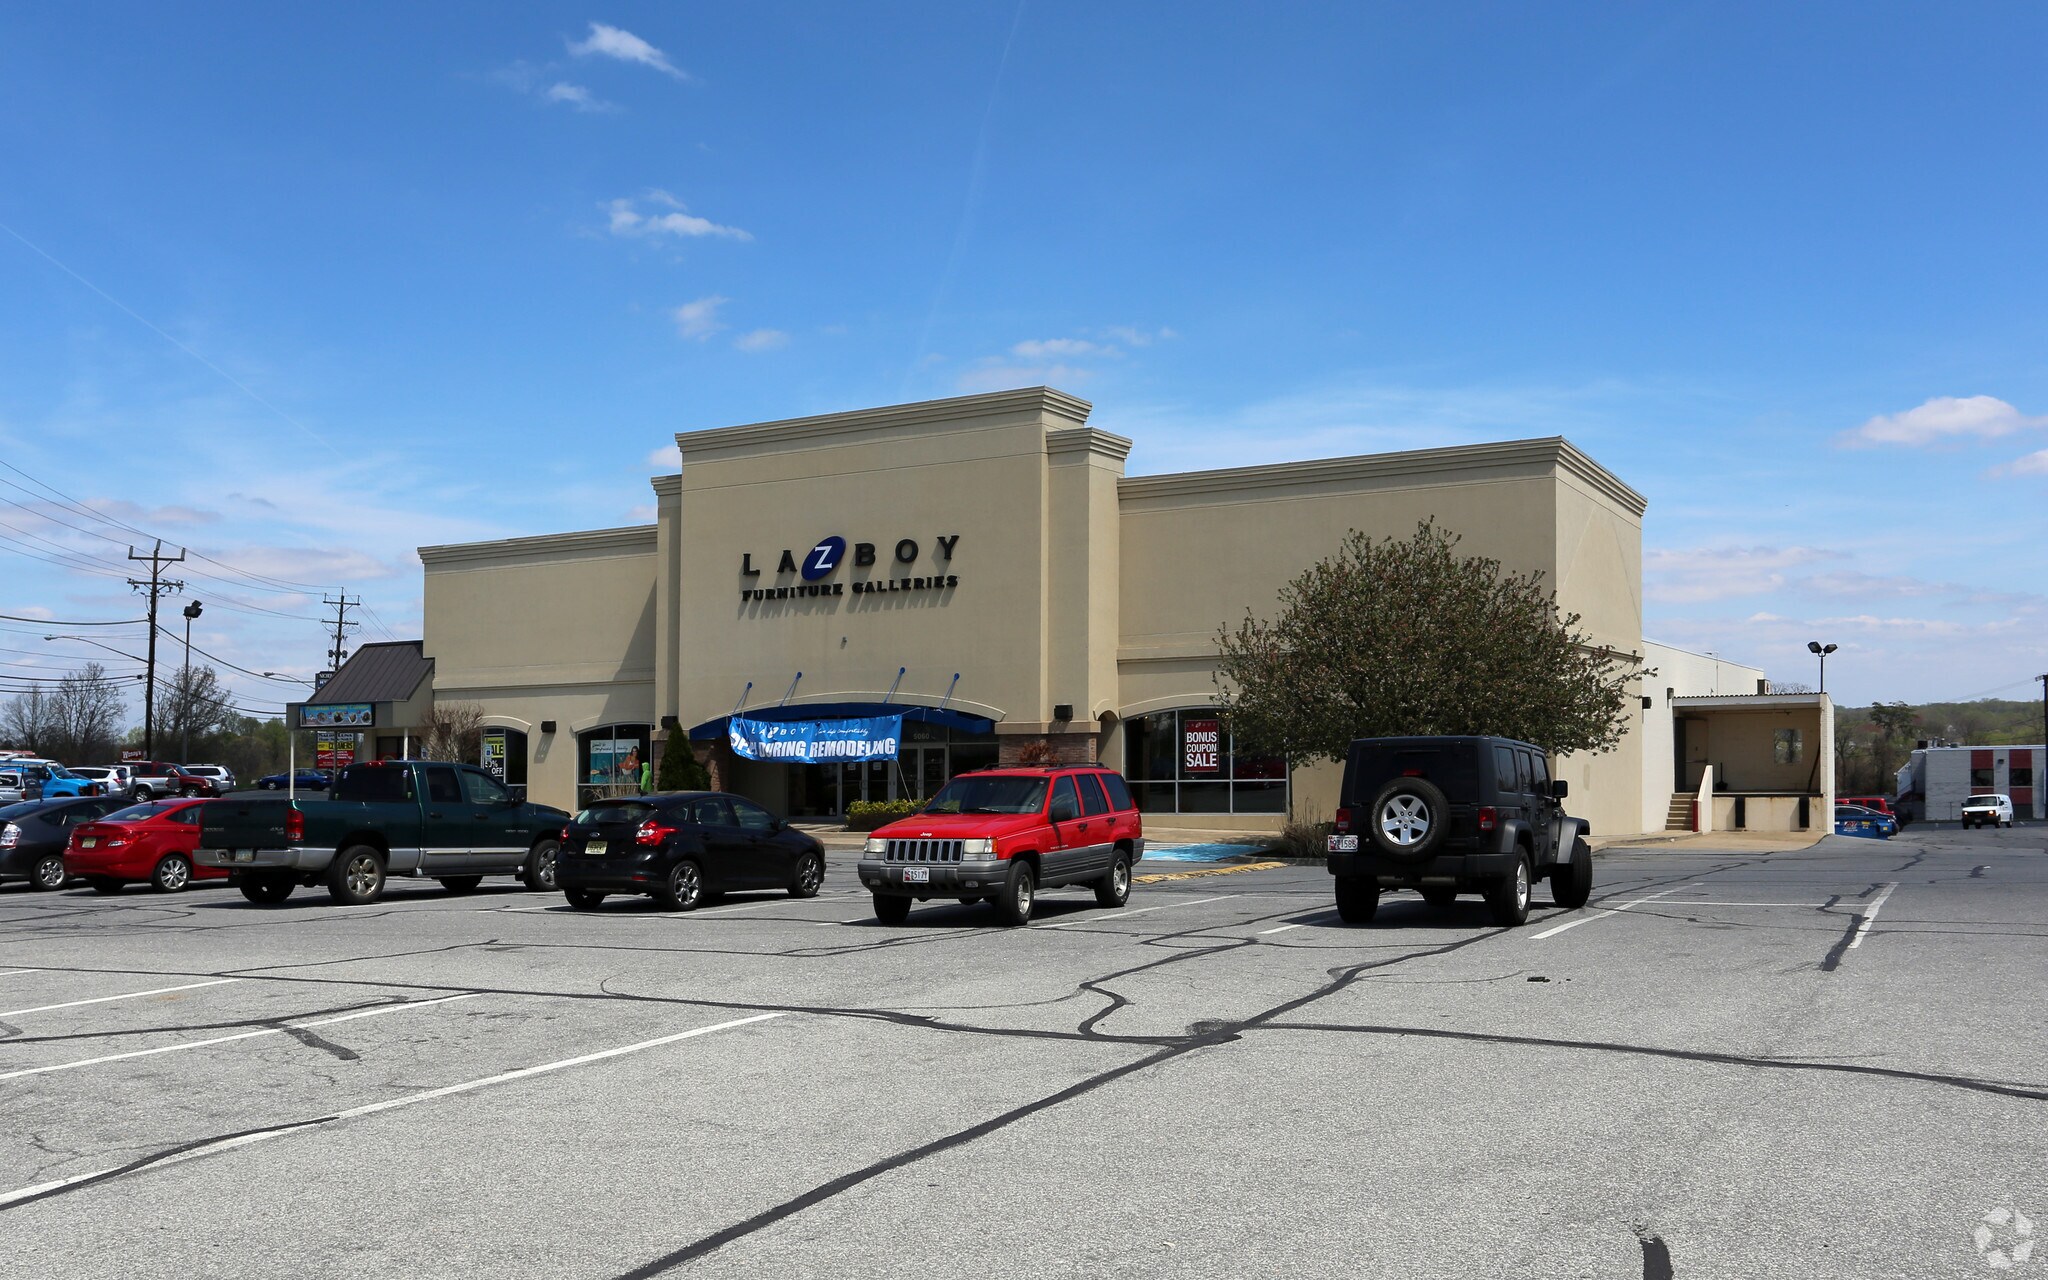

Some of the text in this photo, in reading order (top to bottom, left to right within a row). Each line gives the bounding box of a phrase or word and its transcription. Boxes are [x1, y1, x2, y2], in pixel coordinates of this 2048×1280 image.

[742, 575, 958, 601] FURNITURE GALLERIES
[1187, 731, 1217, 743] BONUS
[759, 741, 807, 758] DURING
[1187, 743, 1217, 753] COUPON
[1187, 753, 1217, 767] SALE
[491, 767, 503, 775] OFF
